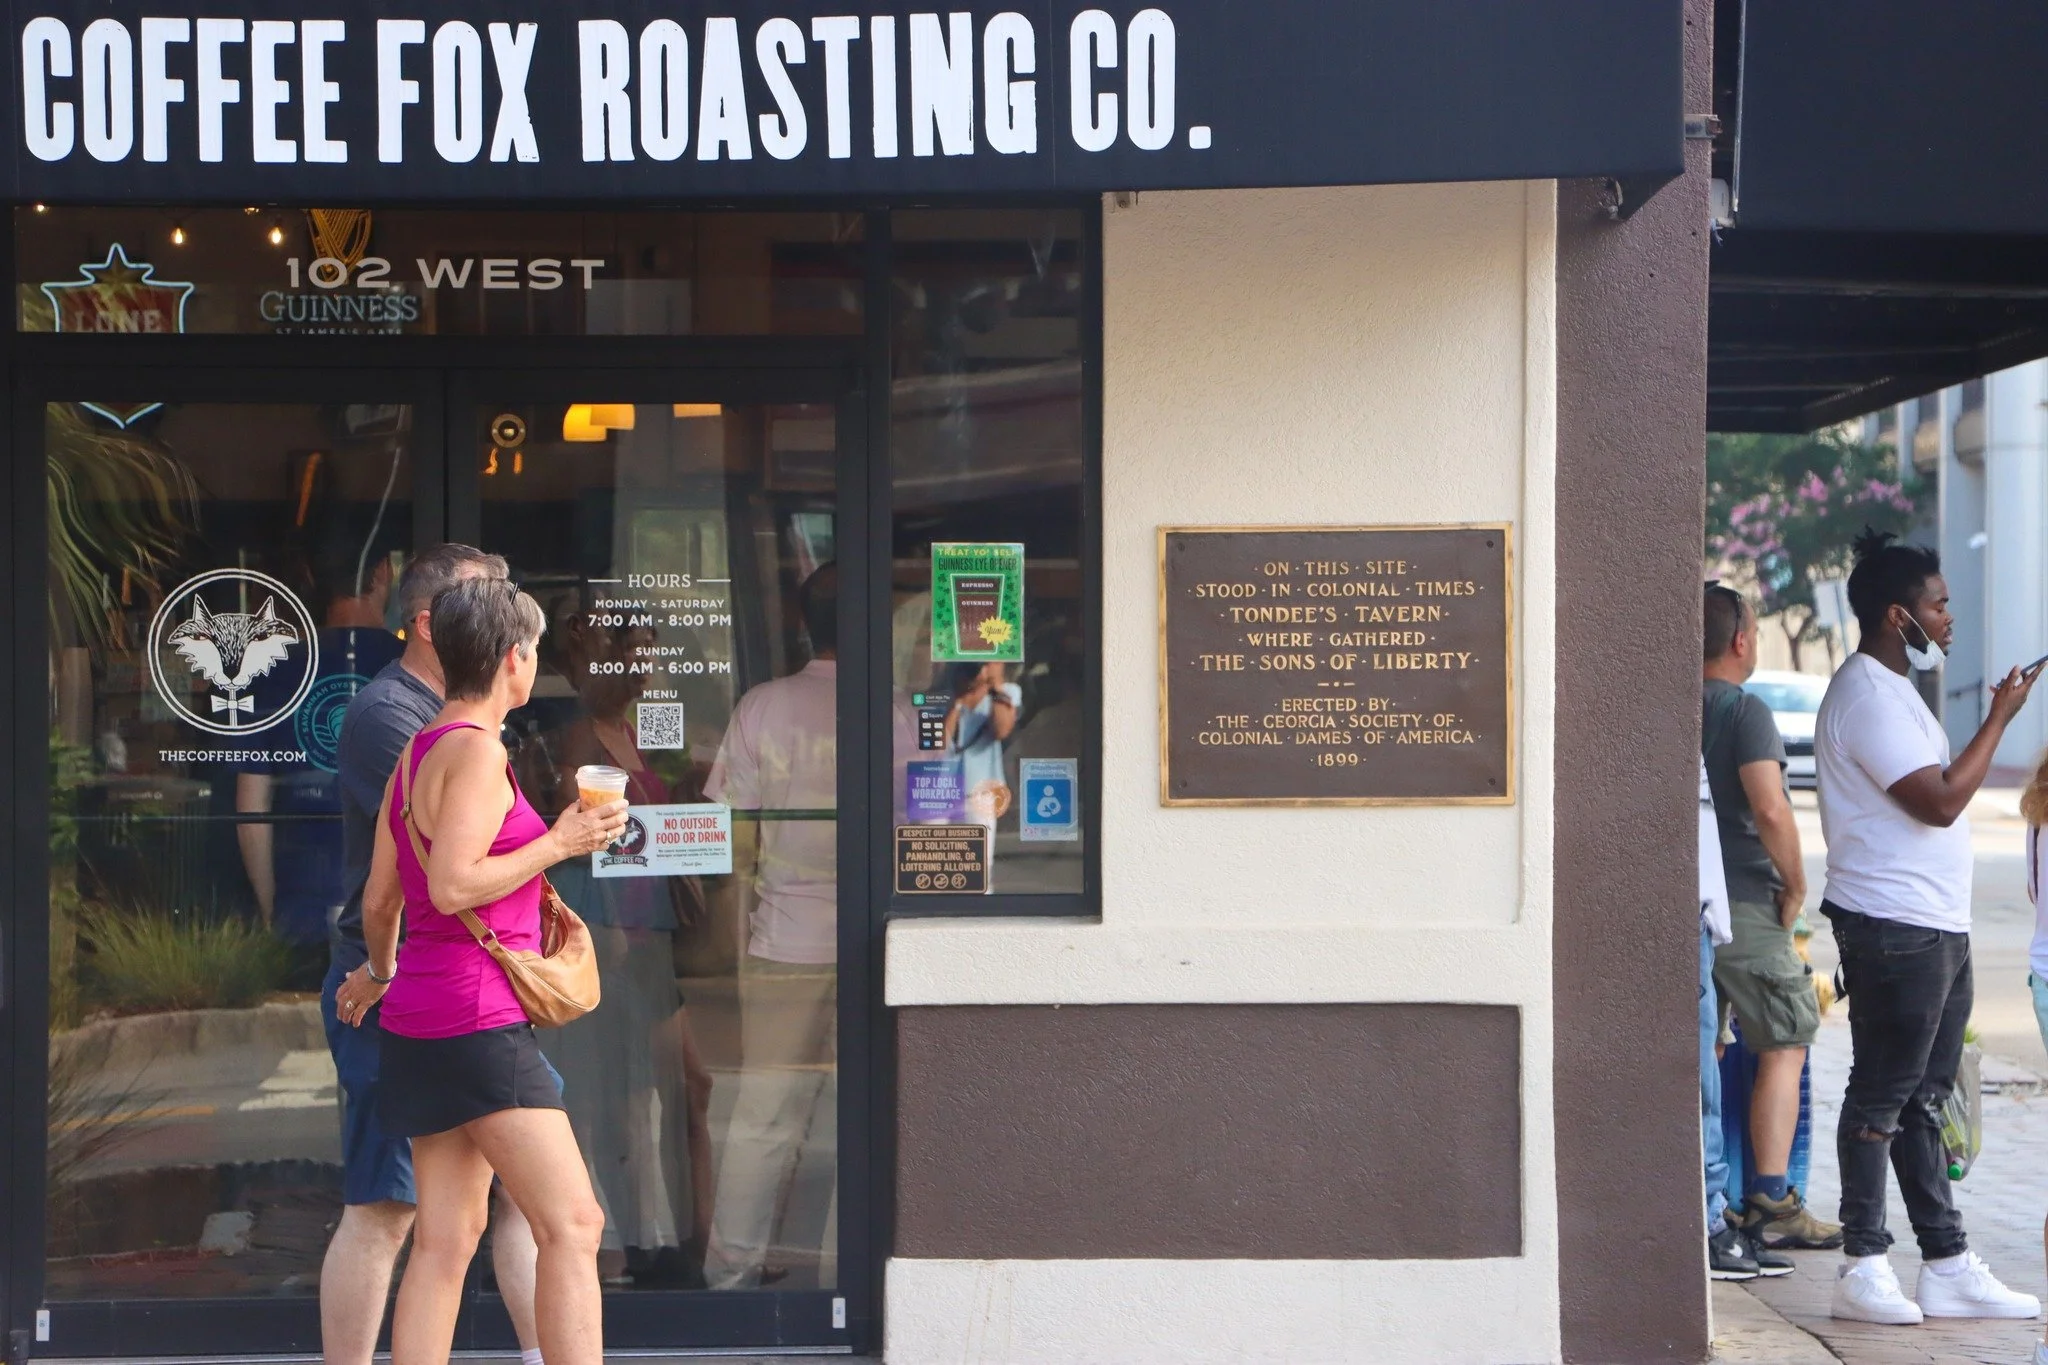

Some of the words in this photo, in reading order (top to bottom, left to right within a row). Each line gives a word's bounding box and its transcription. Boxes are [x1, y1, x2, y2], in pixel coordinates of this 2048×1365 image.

[22, 16, 348, 163] COFFEE
[377, 20, 539, 163] FOX
[578, 12, 1037, 162] ROASTING
[1070, 9, 1212, 151] CO.
[287, 257, 391, 289] 102
[416, 258, 605, 290] WEST
[260, 290, 418, 322] GUINNESS
[975, 558, 988, 570] EYE
[1264, 562, 1289, 576] ON
[1304, 561, 1349, 576] THIS
[1366, 560, 1407, 575] SITE
[628, 574, 691, 588] HOURS
[1196, 584, 1256, 597] STOOD
[1271, 584, 1291, 597] IN
[1307, 582, 1400, 597] COLONIAL
[1415, 581, 1475, 596] TIMES
[595, 599, 648, 608] MONDAY
[661, 599, 725, 608] SATURDAY
[588, 614, 623, 627] 7:00
[628, 614, 652, 626] AM
[668, 614, 704, 626] 8:00
[709, 614, 731, 626] PM
[1230, 606, 1337, 623] TONDEE'S
[1355, 606, 1441, 623] TAVERN
[1247, 633, 1313, 647] WHERE
[1329, 632, 1426, 646] GATHERED
[635, 647, 685, 656] SUNDAY
[589, 662, 624, 674] 8:00
[629, 662, 653, 674] AM
[668, 662, 703, 674] 6:00
[708, 662, 731, 673] PM
[1199, 655, 1245, 671] THE
[1259, 654, 1316, 670] SONS
[1330, 654, 1357, 670] OF
[1373, 652, 1472, 669] LIBERTY
[643, 690, 678, 699] MENU
[1282, 699, 1357, 712] ERECTED
[1369, 698, 1391, 711] BY
[1216, 715, 1249, 728] THE
[1263, 715, 1336, 728] GEORGIA
[1349, 714, 1422, 728] SOCIETY
[1433, 714, 1456, 726] OF
[1199, 732, 1283, 745] COLONIAL
[1295, 731, 1352, 744] DAMES
[1364, 731, 1386, 744] OF
[1397, 730, 1474, 744] AMERICA
[159, 750, 307, 762] THECOFFEEFOX.COM
[1317, 754, 1359, 767] 1899
[915, 777, 931, 788] TOP
[932, 776, 957, 788] LOCAL
[912, 788, 961, 800] WORKPLACE
[664, 819, 677, 830] NO
[680, 817, 718, 829] OUTSIDE
[656, 833, 680, 844] FOOD
[683, 832, 697, 843] OR
[698, 831, 726, 843] DRINK
[912, 842, 922, 850] NO
[965, 852, 976, 860] OR
[901, 863, 941, 871] LOITERING
[944, 863, 981, 871] ALLOWED
